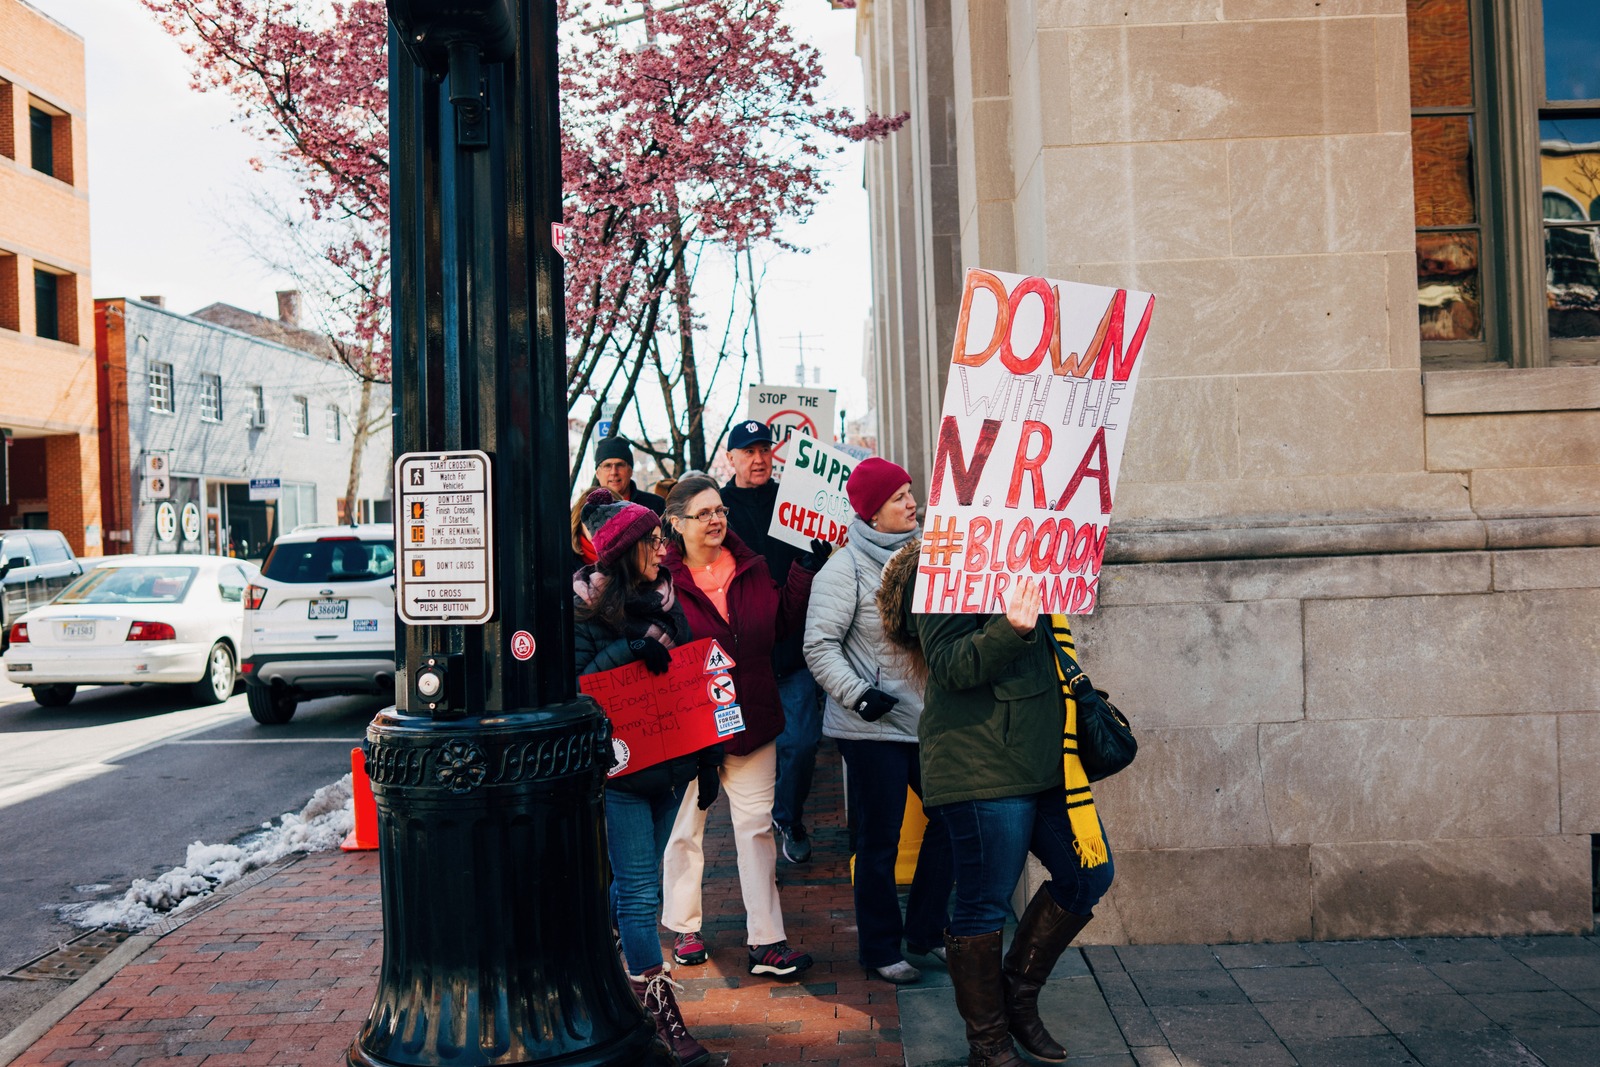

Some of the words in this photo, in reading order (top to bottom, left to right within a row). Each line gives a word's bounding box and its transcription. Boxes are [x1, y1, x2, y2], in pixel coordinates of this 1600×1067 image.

[952, 268, 1156, 382] DOWN
[759, 392, 787, 405] STOP
[797, 395, 819, 408] THE
[958, 366, 1053, 423] WITH
[1062, 375, 1127, 431] THE
[430, 461, 447, 470] START
[448, 460, 476, 469] CROSSING
[795, 438, 852, 492] SUPP
[440, 472, 456, 481] Watch
[458, 472, 467, 481] For
[443, 482, 464, 490] Vehicles
[438, 495, 455, 504] DON'T
[456, 494, 473, 503] START
[436, 506, 450, 515] Finish
[453, 506, 476, 516] Crossing
[813, 489, 851, 524] OUR
[449, 515, 469, 524] Started
[778, 501, 849, 549] CHILDR
[432, 528, 445, 536] TIME
[449, 527, 480, 536] REMAINING
[431, 537, 437, 545] To
[440, 537, 456, 545] Finish
[459, 536, 481, 546] Crossing
[437, 561, 453, 570] DON'T
[456, 561, 475, 570] CROSS
[427, 589, 436, 598] TO
[440, 589, 462, 598] CROSS
[919, 565, 1012, 614] THEIR
[420, 603, 439, 612] PUSH
[443, 603, 469, 612] BUTTON
[583, 665, 649, 692] #NEVE
[672, 645, 707, 670] GAIN
[717, 709, 736, 719] MARCH
[718, 716, 728, 724] FOR
[729, 713, 740, 721] OUR
[642, 714, 681, 737] NOW!
[719, 721, 734, 730] LIVES
